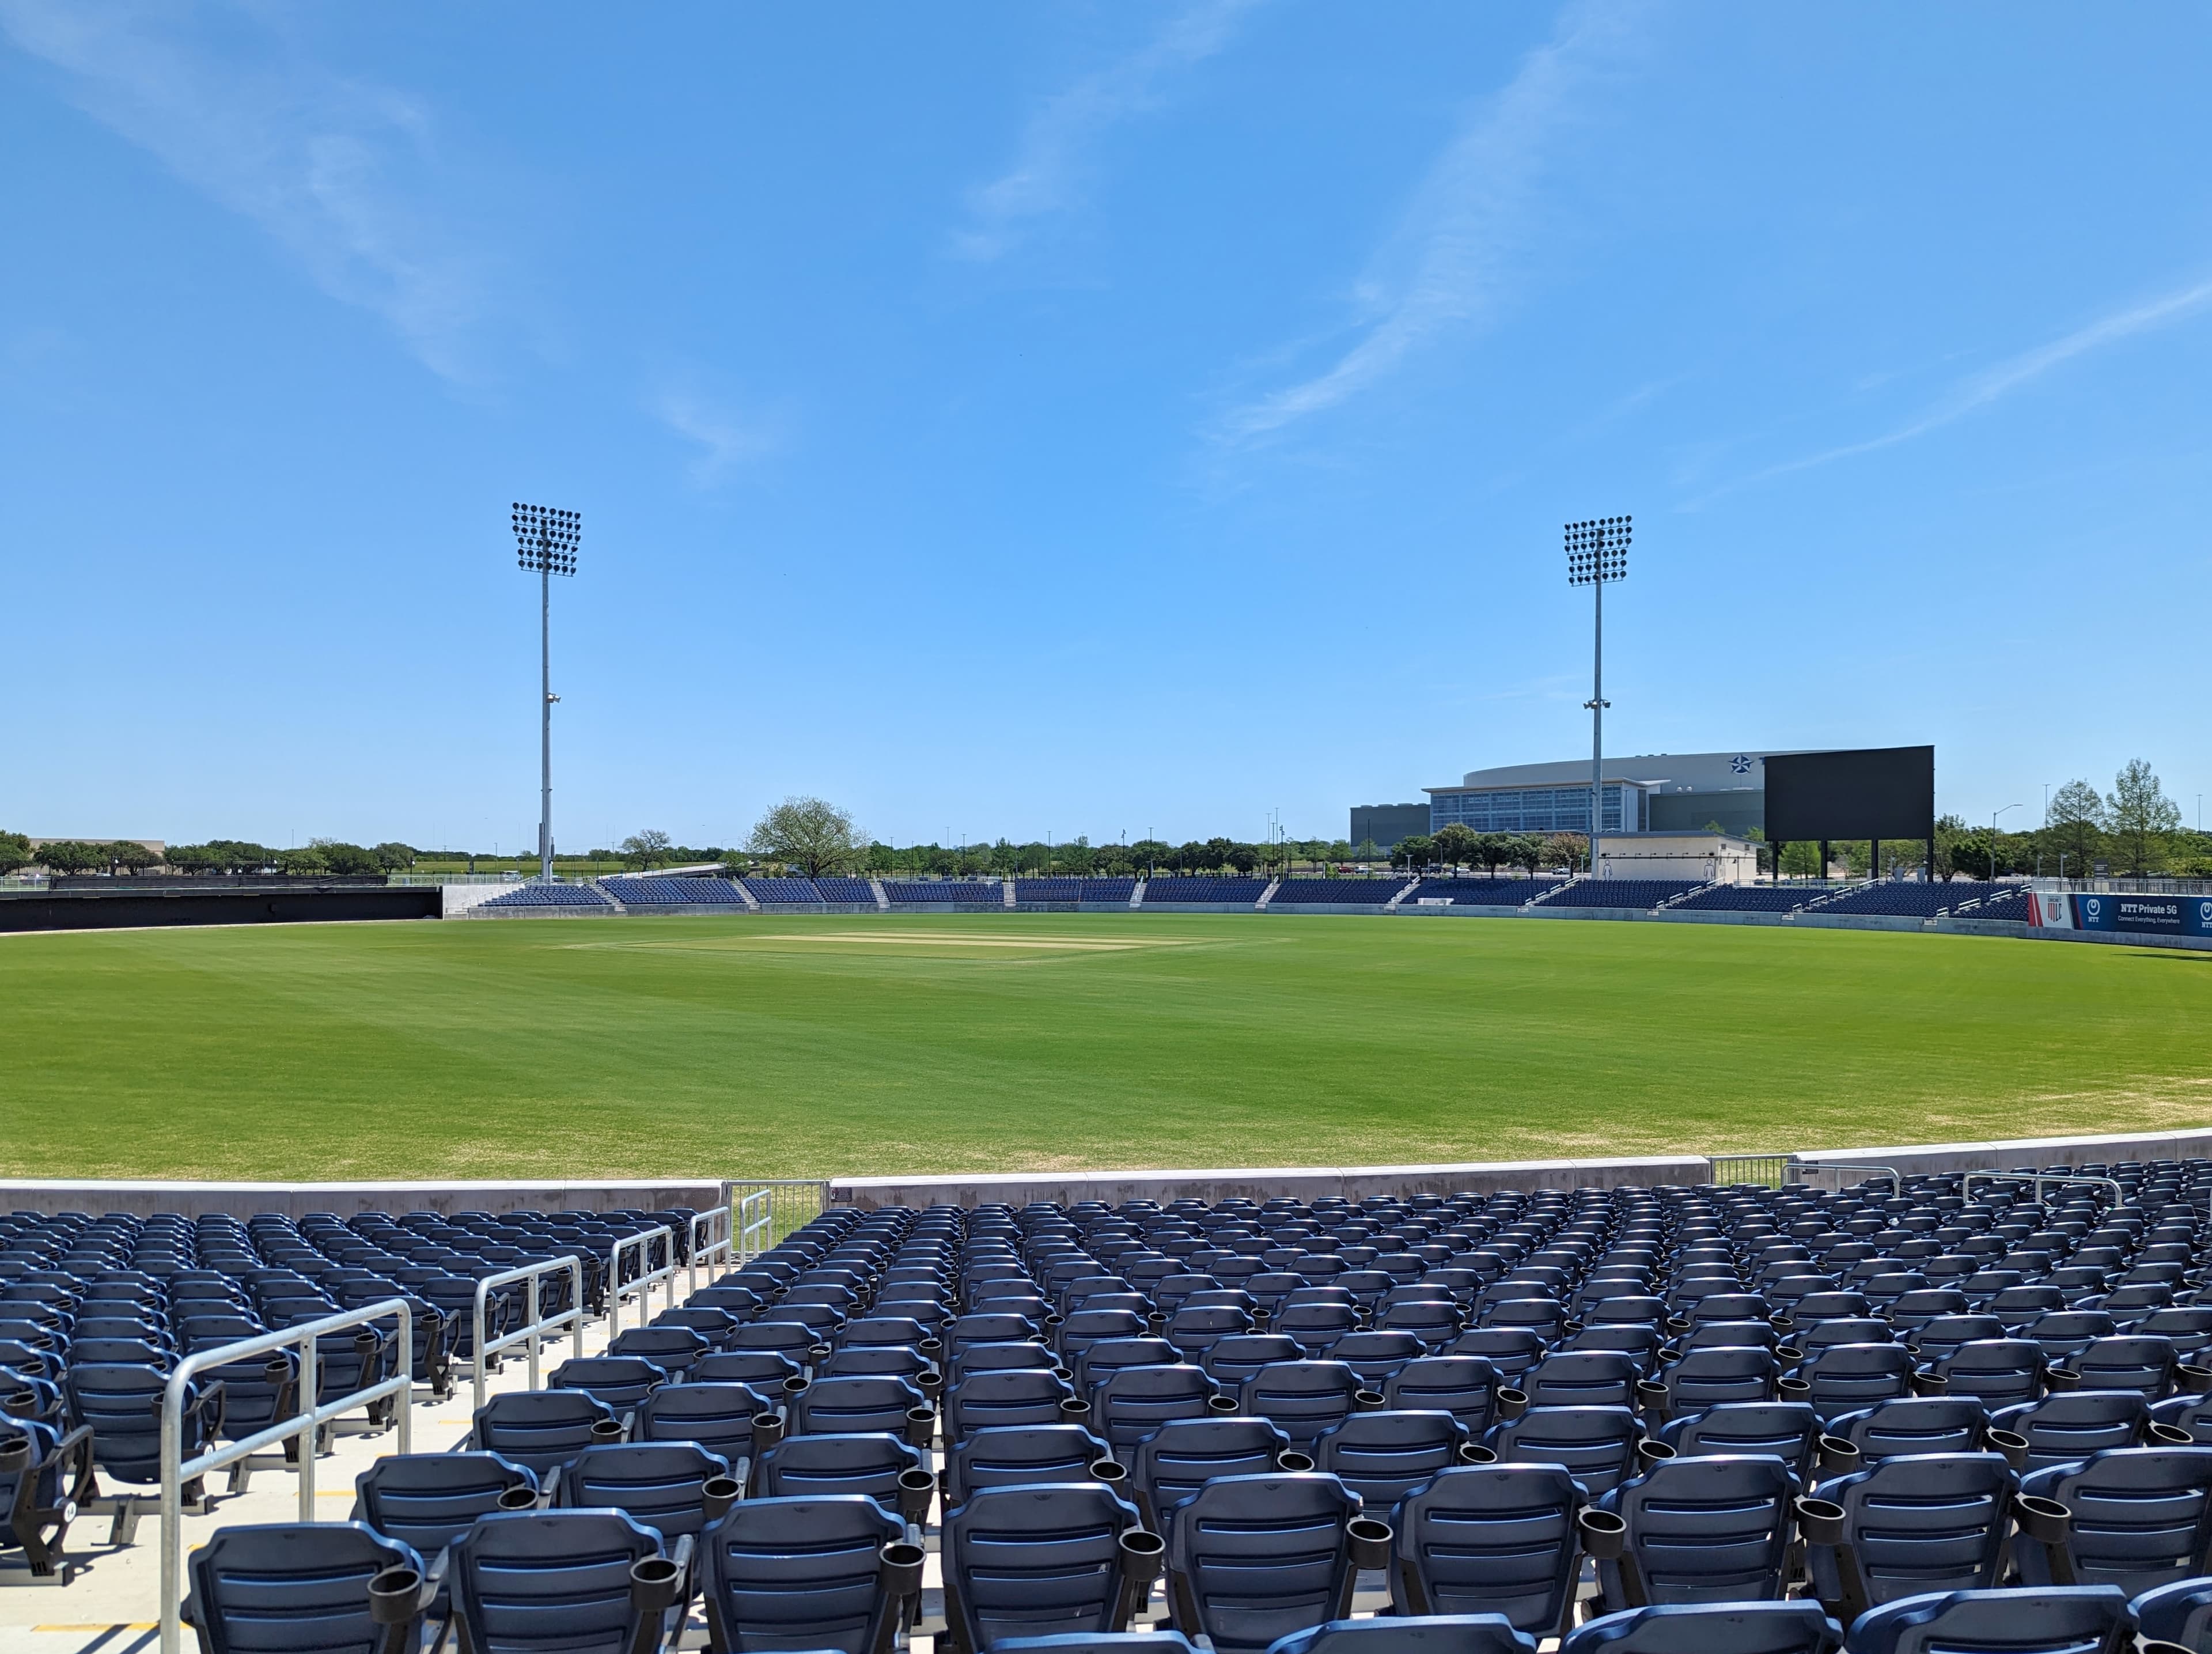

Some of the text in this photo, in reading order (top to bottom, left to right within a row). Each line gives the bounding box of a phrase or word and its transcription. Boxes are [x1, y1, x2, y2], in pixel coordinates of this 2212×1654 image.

[2120, 903, 2177, 914] NTT Private 5G
